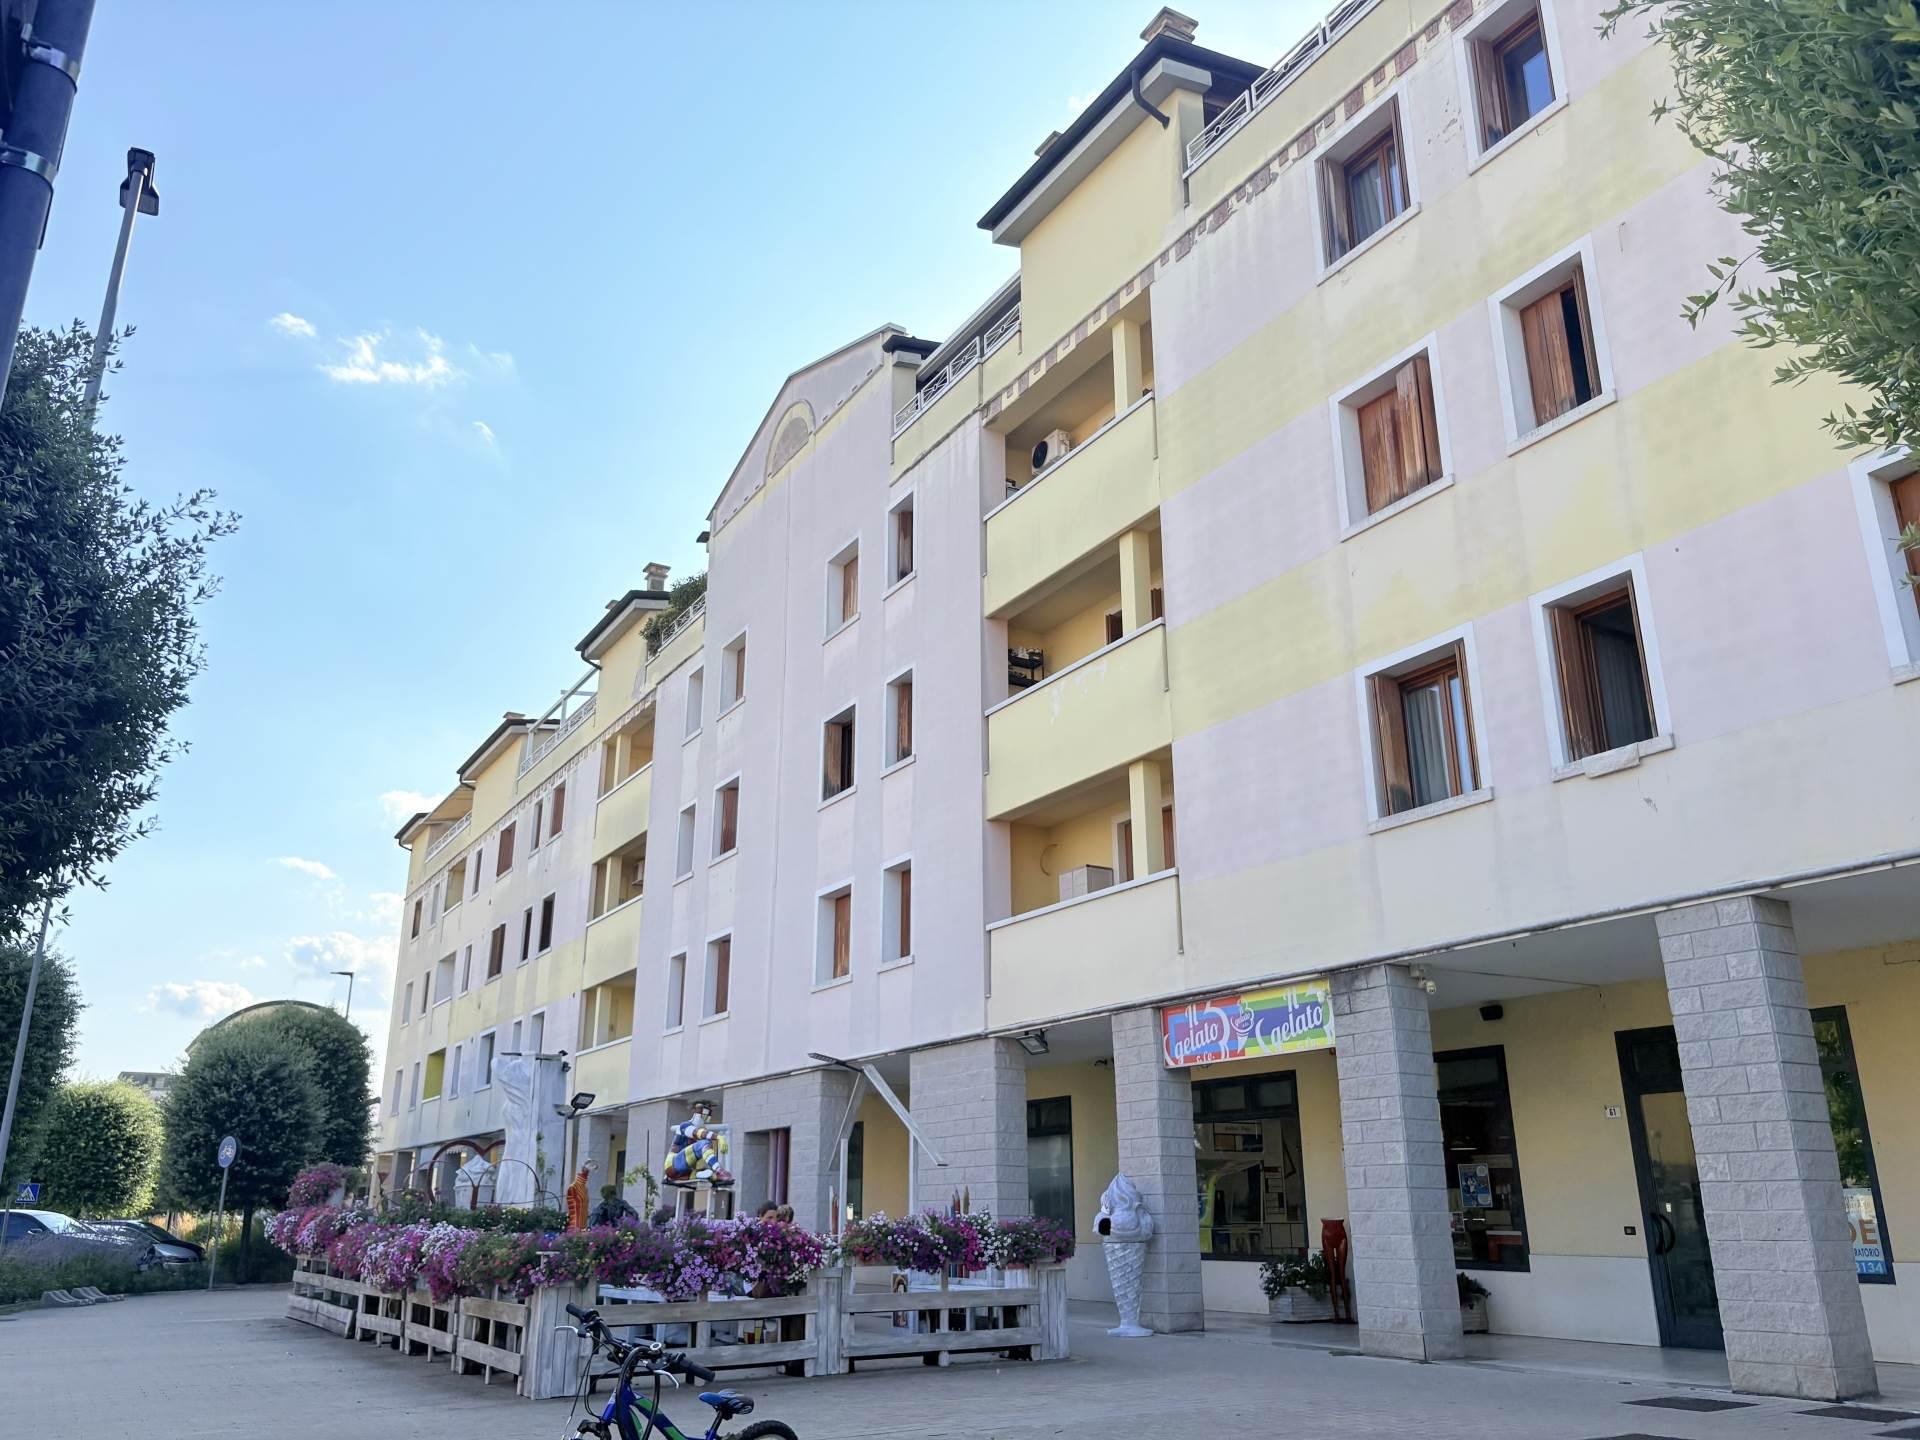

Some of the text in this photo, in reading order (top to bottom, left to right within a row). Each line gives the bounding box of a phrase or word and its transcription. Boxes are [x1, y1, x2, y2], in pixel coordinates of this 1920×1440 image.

[1283, 985, 1299, 1010] Il
[1185, 1004, 1199, 1028] Il
[1271, 1004, 1323, 1053] gelato
[1175, 1022, 1218, 1065] gelato
